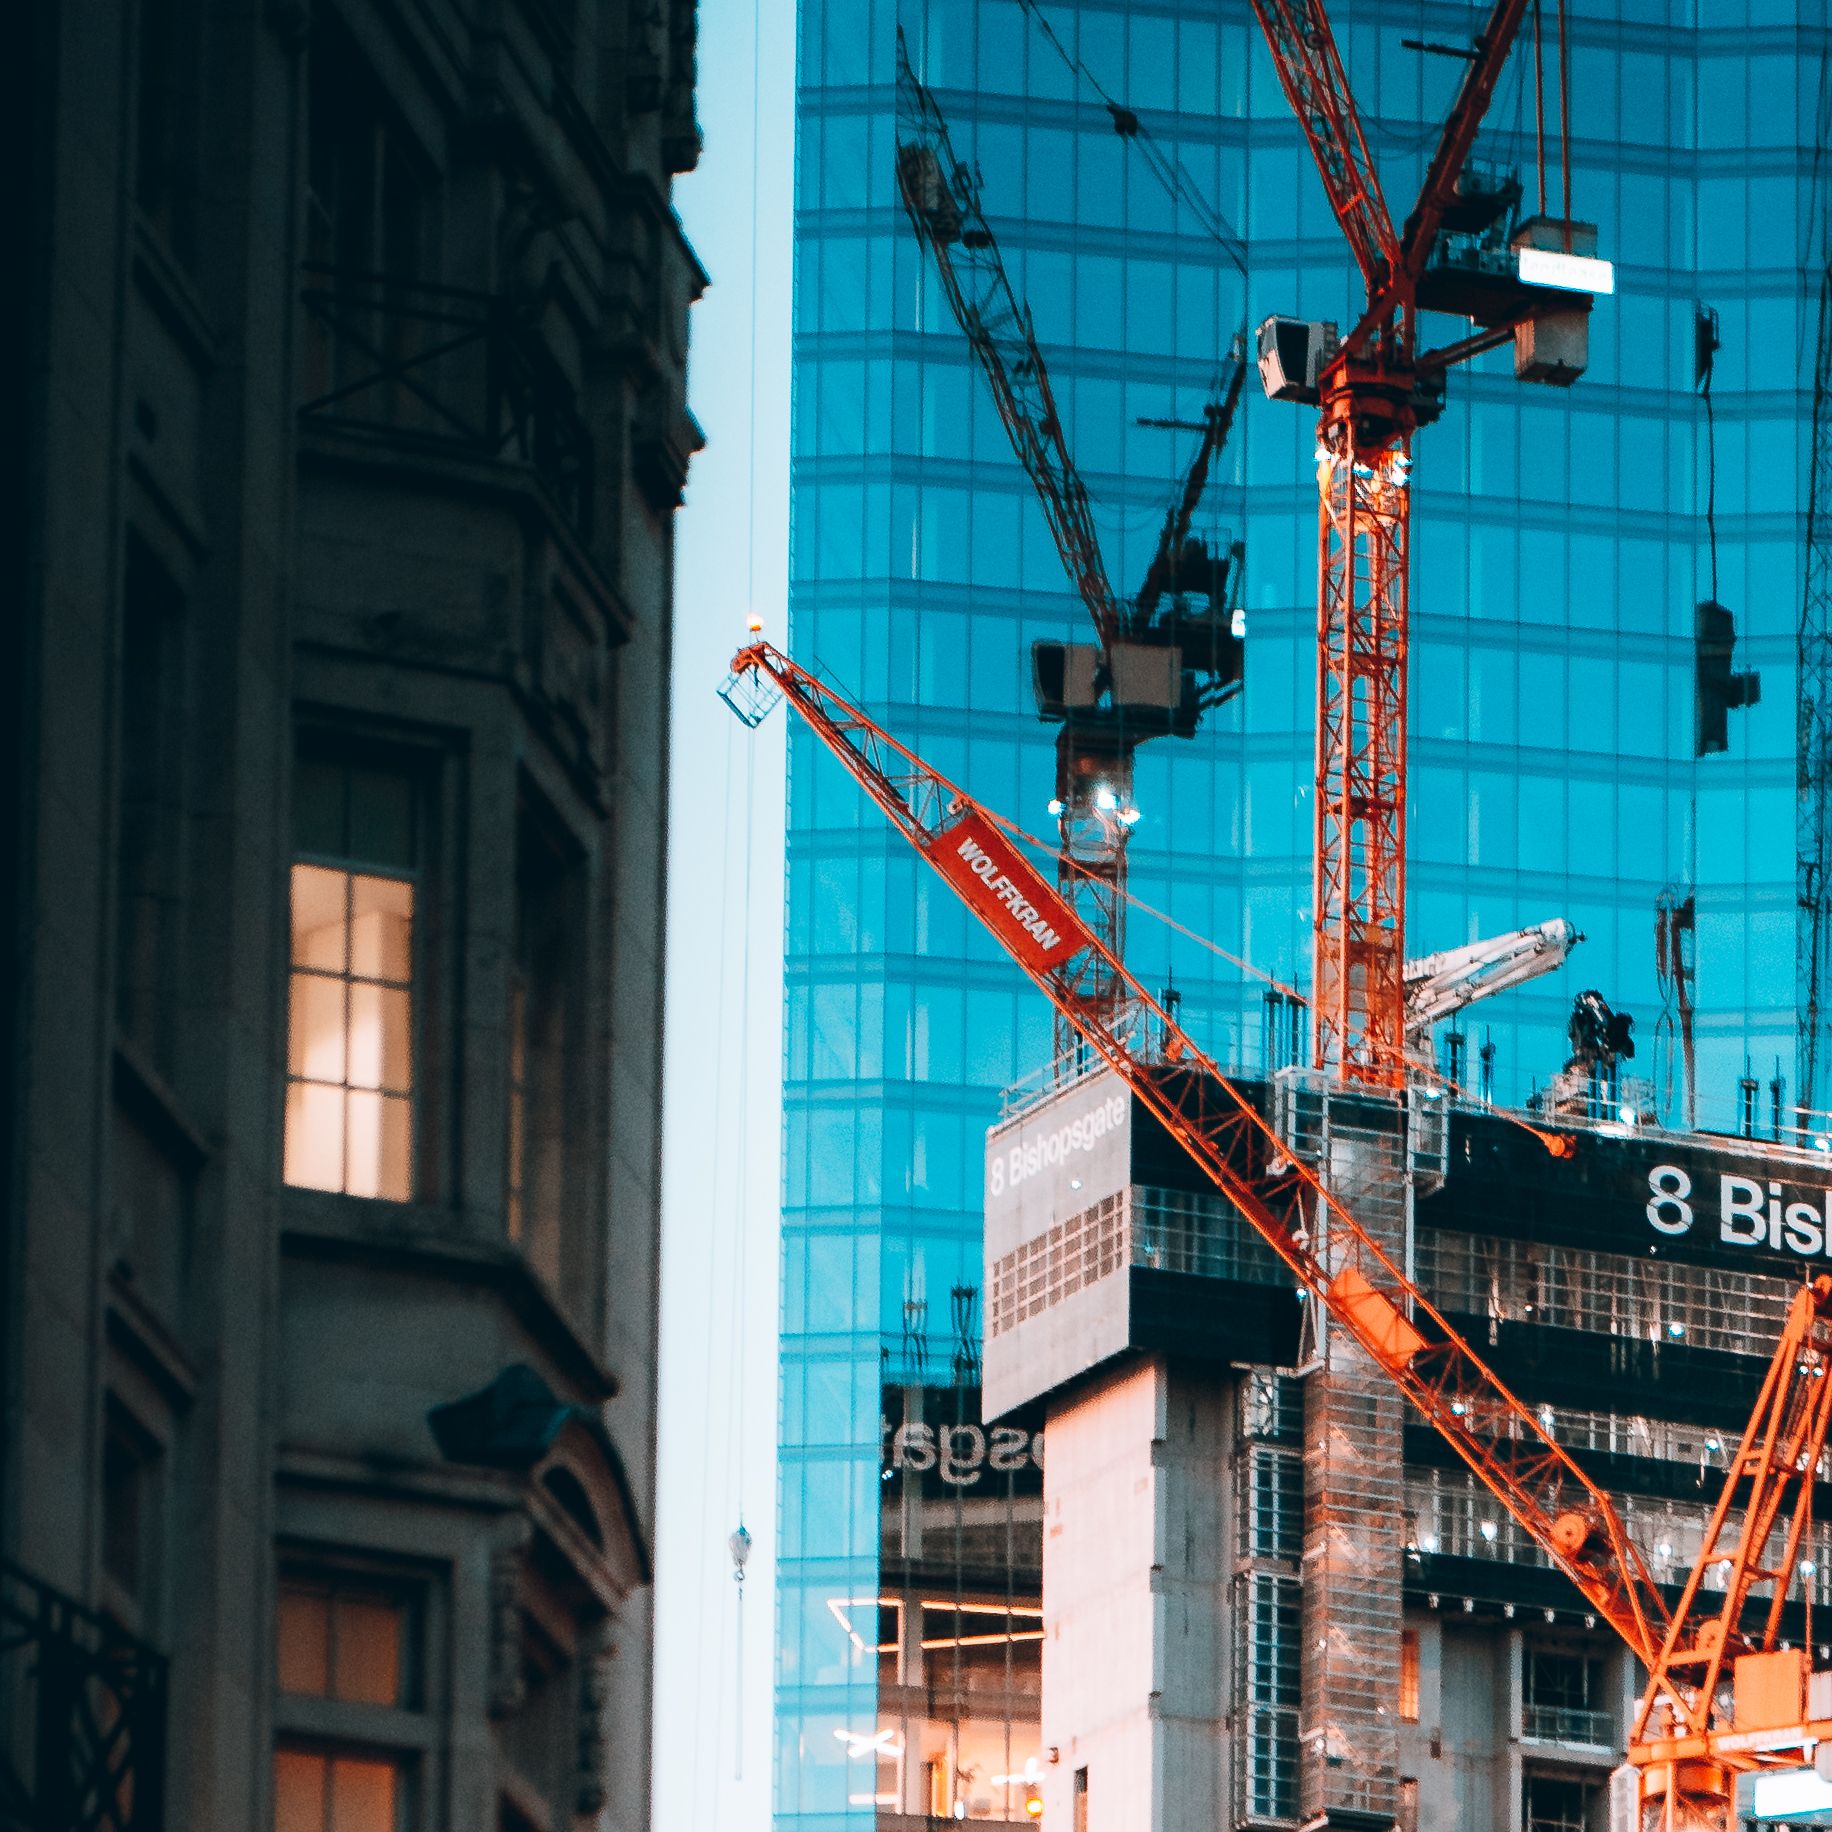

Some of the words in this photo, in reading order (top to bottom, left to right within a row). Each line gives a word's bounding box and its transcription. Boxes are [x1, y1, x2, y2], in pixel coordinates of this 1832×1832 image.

[957, 838, 1061, 951] WOLFFKRAN
[991, 1156, 1004, 1197] 8
[1009, 1096, 1126, 1187] Bishopsgate
[1646, 1165, 1693, 1235] 8
